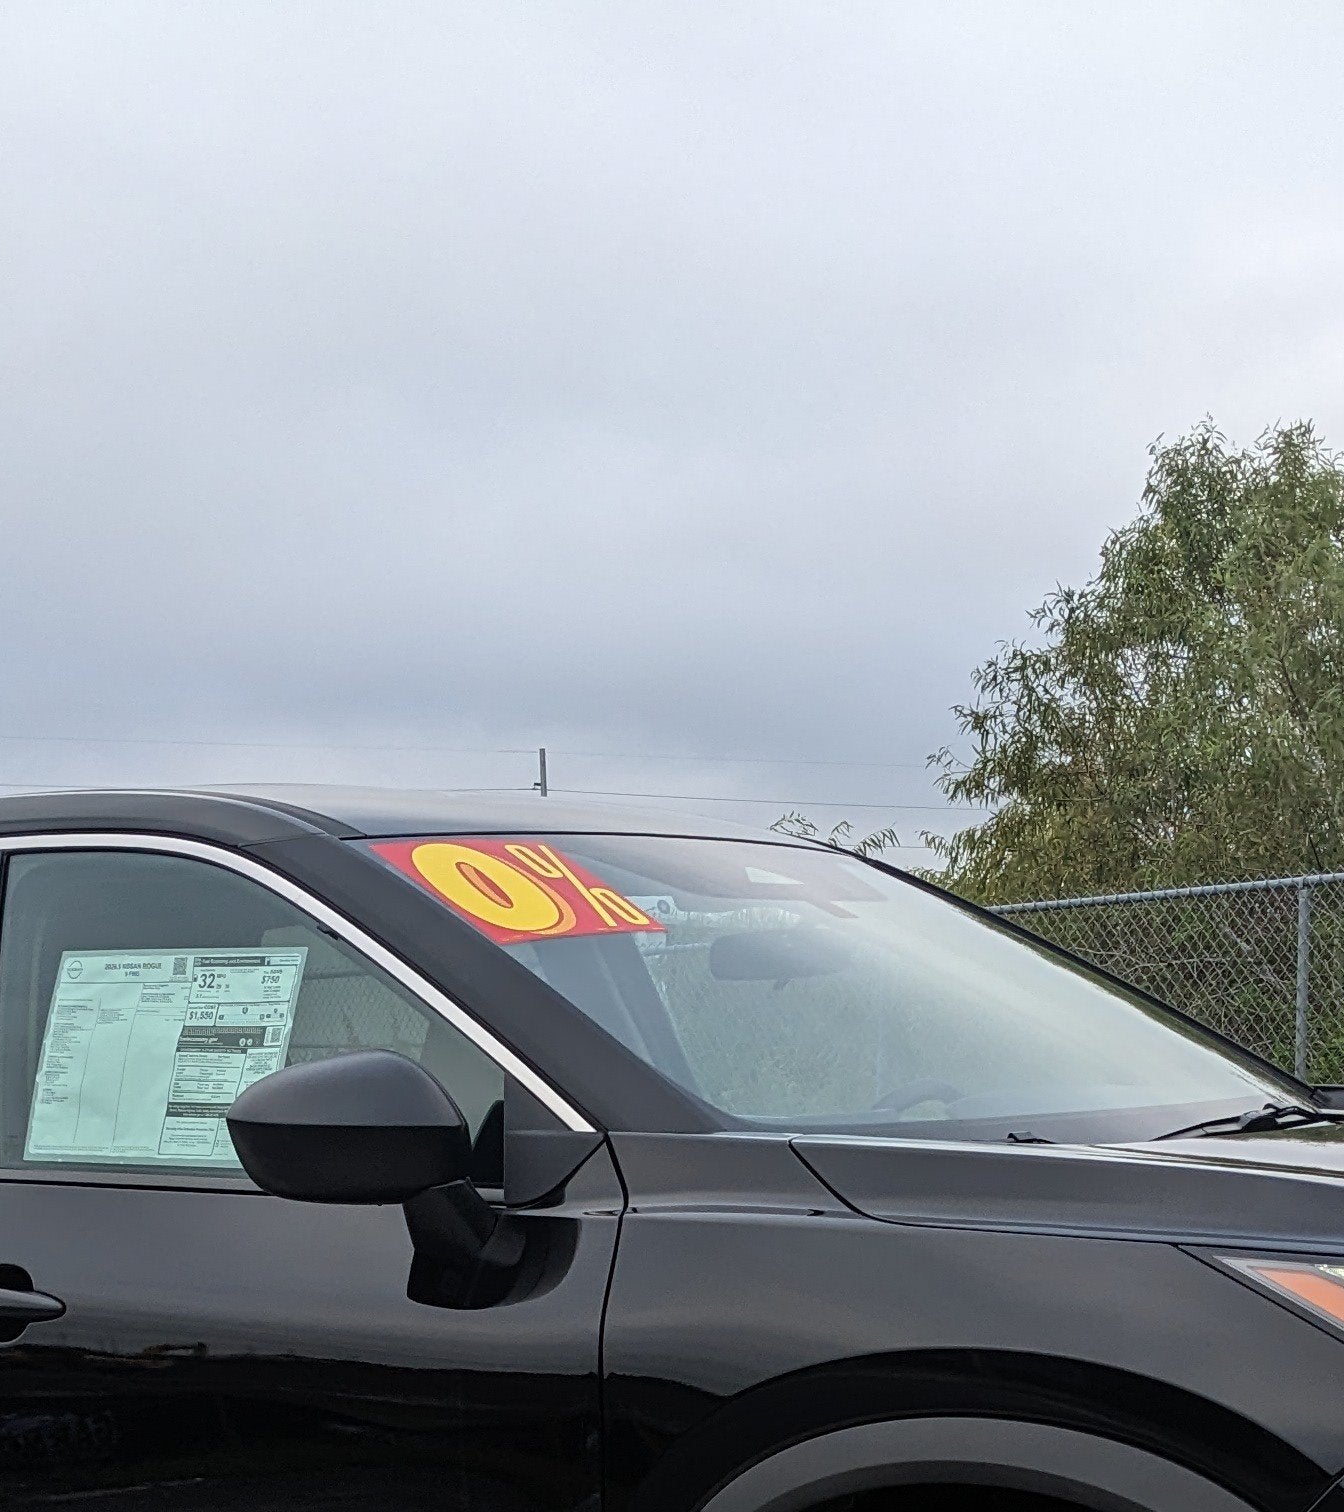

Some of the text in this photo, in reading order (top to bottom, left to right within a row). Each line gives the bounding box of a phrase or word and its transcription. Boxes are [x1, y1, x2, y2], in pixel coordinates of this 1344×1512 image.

[411, 843, 650, 935] 0%
[142, 962, 162, 970] ROGUE
[198, 973, 216, 989] 32
[261, 975, 280, 984] $750
